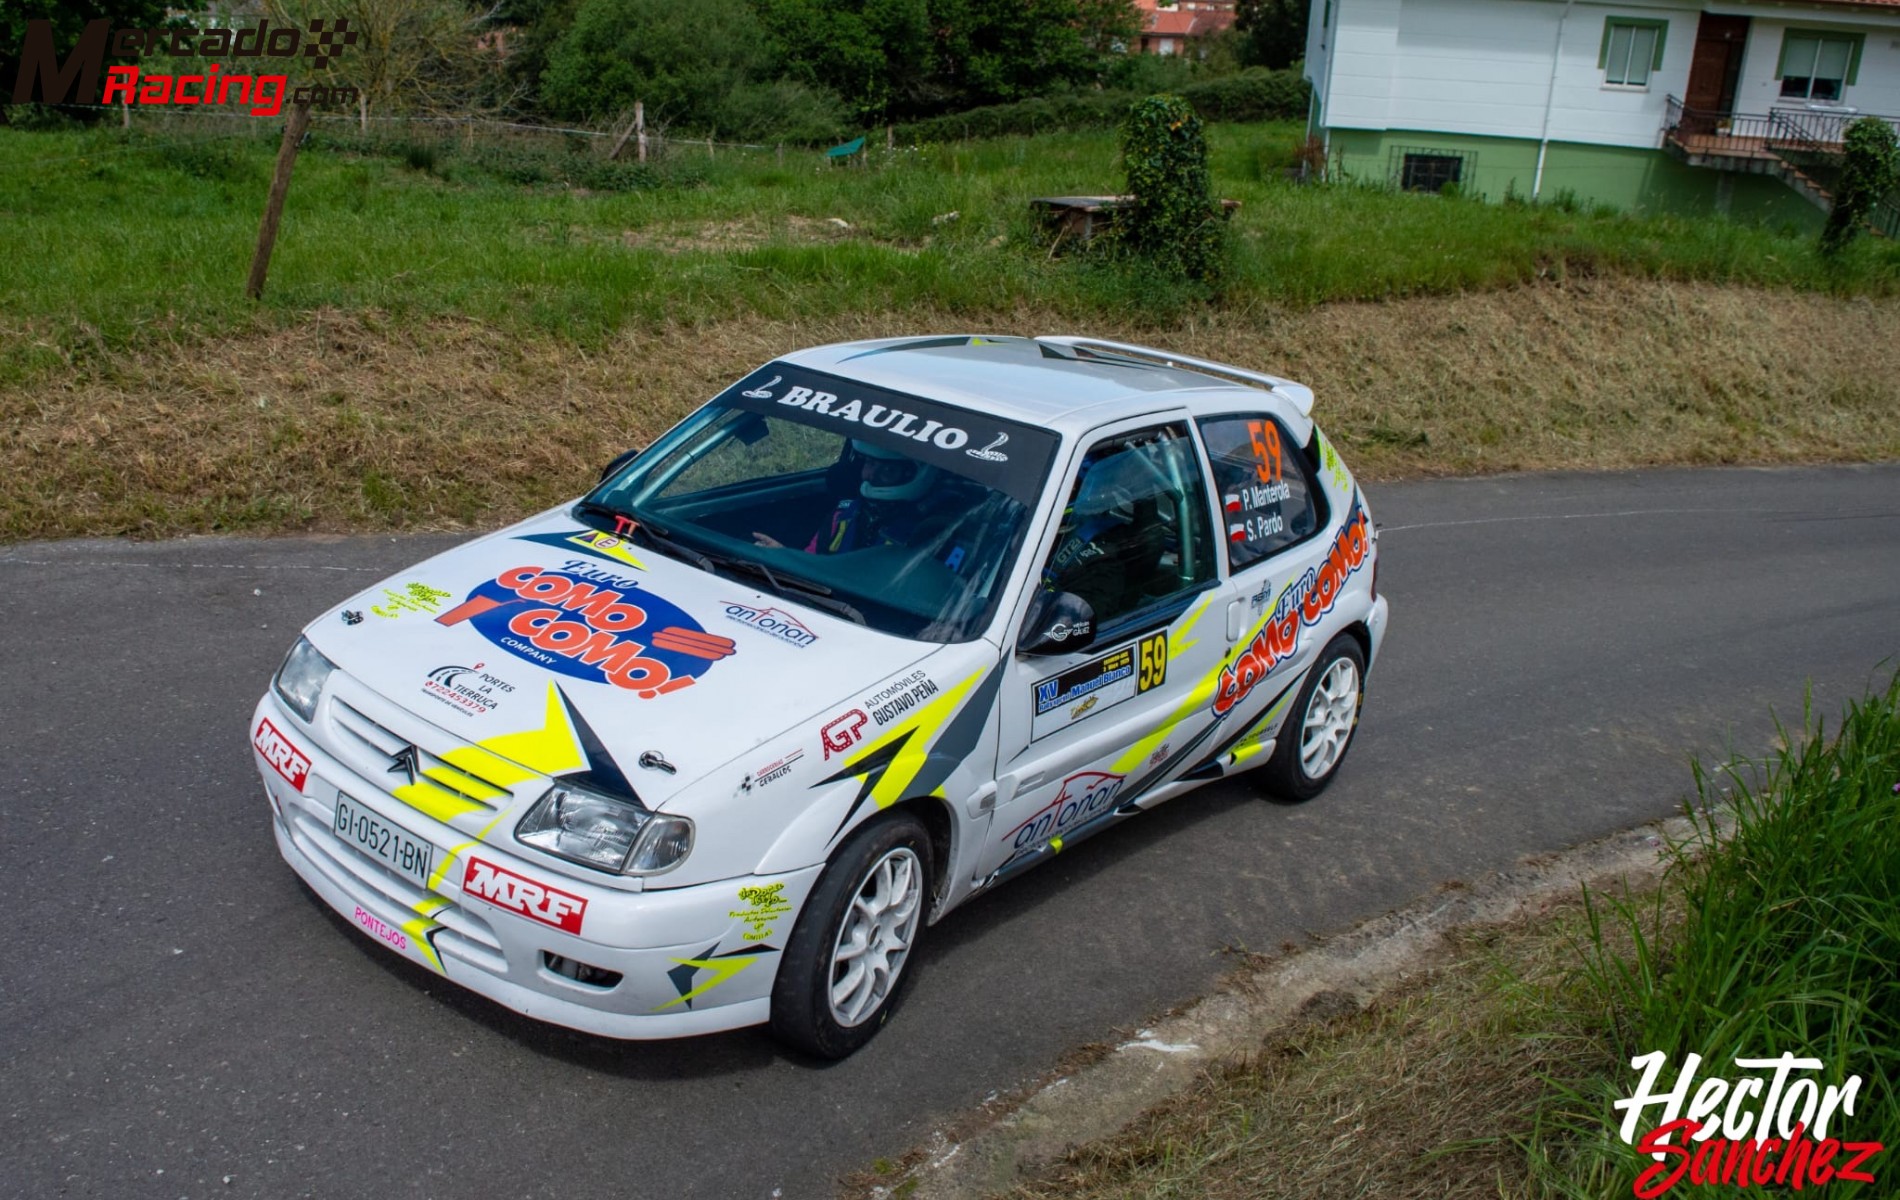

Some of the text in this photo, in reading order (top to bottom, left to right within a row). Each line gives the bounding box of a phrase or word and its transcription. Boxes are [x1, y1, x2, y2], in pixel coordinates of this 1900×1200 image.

[777, 386, 968, 449] BRAULIO
[1248, 420, 1282, 484] 59
[1243, 481, 1290, 511] P. Manterola
[1246, 515, 1283, 542] S. Pardo
[560, 559, 639, 588] Euro
[1301, 508, 1370, 625] COMO!
[496, 566, 647, 632] COMO
[1275, 567, 1316, 622] Euro
[501, 636, 557, 666] COMPANY
[508, 608, 696, 700] COMO!
[1139, 634, 1167, 691] 59
[1212, 608, 1300, 715] COMO
[453, 683, 499, 710] TIERRUCA
[478, 673, 516, 693] PORTES
[478, 685, 493, 694] LA
[864, 670, 926, 710] AUTOMÓVILES
[872, 678, 939, 726] GUSTAVO PEÑA
[1039, 679, 1058, 702] XV
[1071, 675, 1103, 698] Manuel
[1103, 665, 1131, 685] Blanco
[257, 726, 306, 783] MRF
[465, 861, 579, 926] MRF
[355, 906, 406, 950] PONTEJOS
